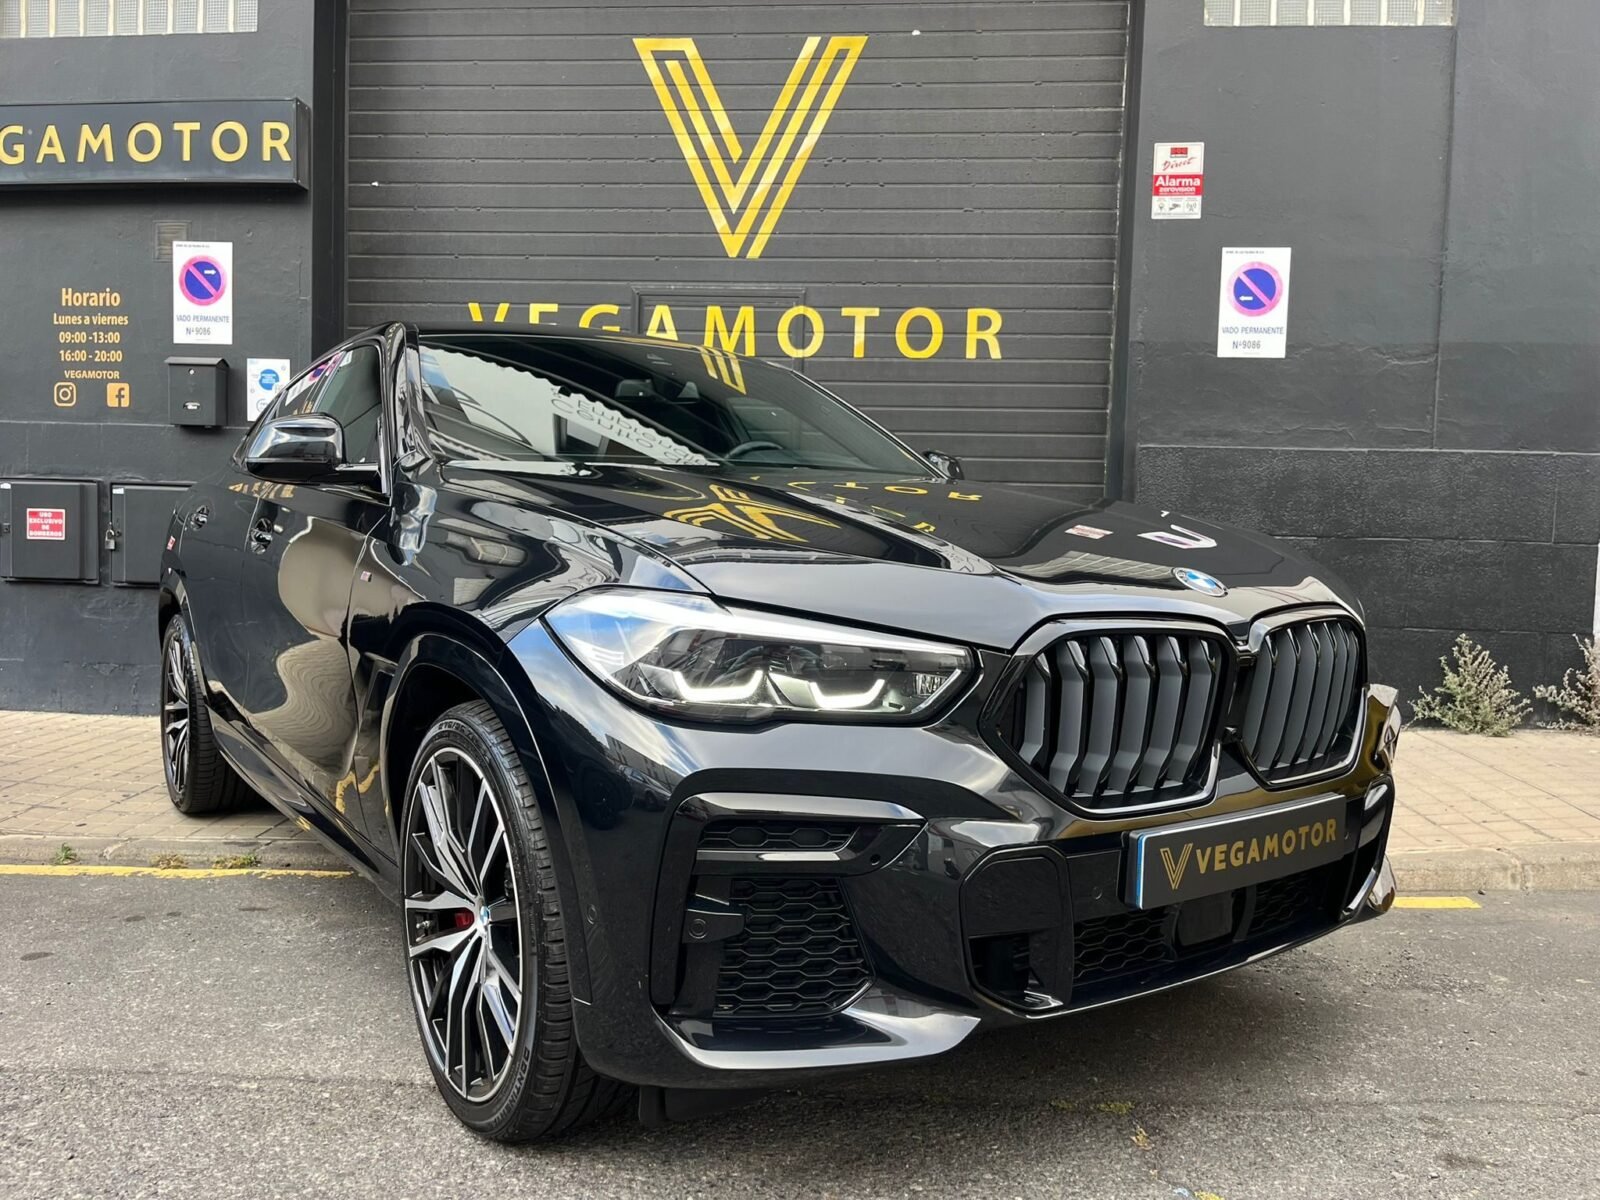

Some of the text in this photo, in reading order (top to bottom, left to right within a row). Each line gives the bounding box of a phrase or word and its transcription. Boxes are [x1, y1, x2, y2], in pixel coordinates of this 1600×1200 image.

[1155, 175, 1201, 187] Alarma
[61, 287, 121, 307] Horario
[53, 313, 129, 326] Lunes a viernes
[176, 314, 230, 324] VADO PERMANENTE
[1221, 326, 1285, 335] VADO PERMANENTE
[59, 331, 87, 344] 09:00
[59, 349, 87, 362] 16:00
[94, 349, 123, 363] 20:00
[64, 369, 120, 380] VEGAMOTOR
[29, 517, 63, 525] EXCLUSIVO
[1196, 818, 1336, 875] VEGAMOTOR
